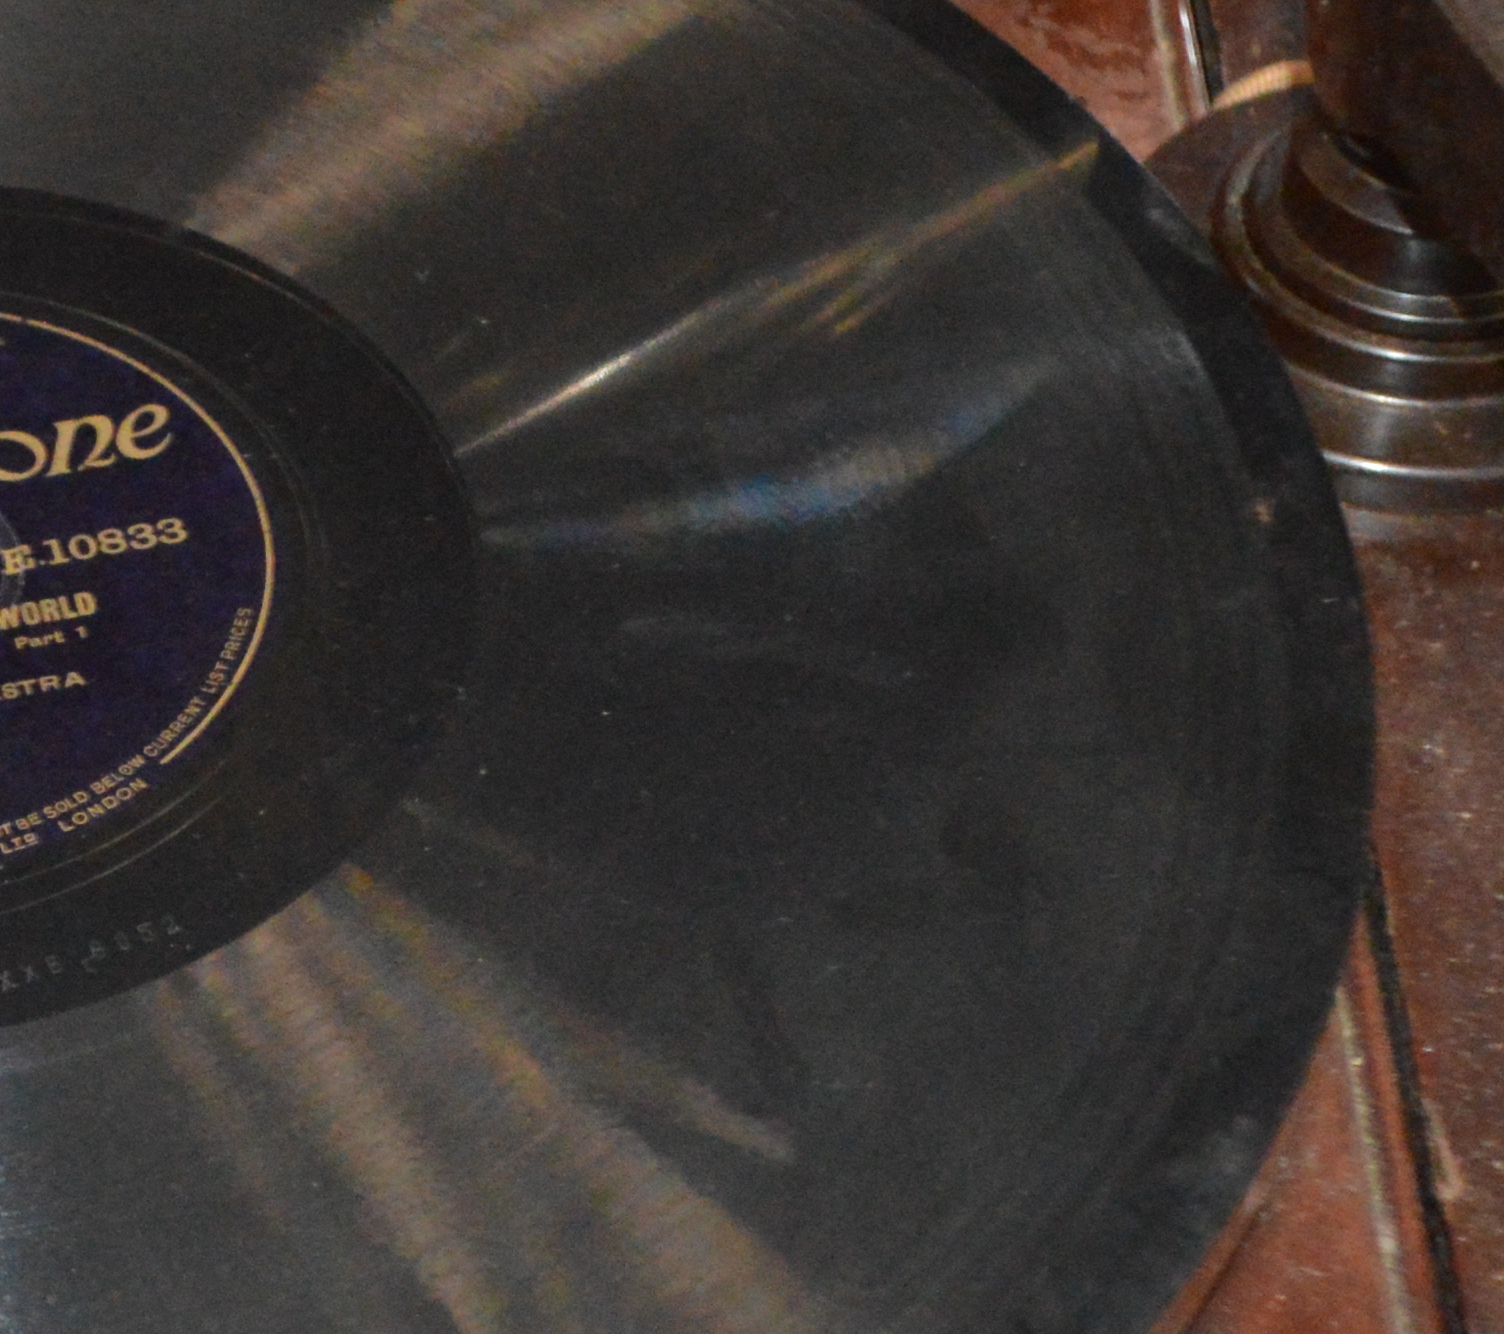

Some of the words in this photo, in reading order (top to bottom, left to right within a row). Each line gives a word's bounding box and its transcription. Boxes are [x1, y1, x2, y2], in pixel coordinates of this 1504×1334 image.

[13, 629, 66, 650] Part
[76, 624, 90, 640] 1
[15, 811, 41, 831] BE
[43, 790, 88, 820] SOLD
[89, 753, 147, 795] BELOW
[143, 695, 207, 758] CURRENT
[200, 659, 232, 695] LIST
[220, 606, 254, 661] PRICES
[57, 777, 151, 832] LONDON
